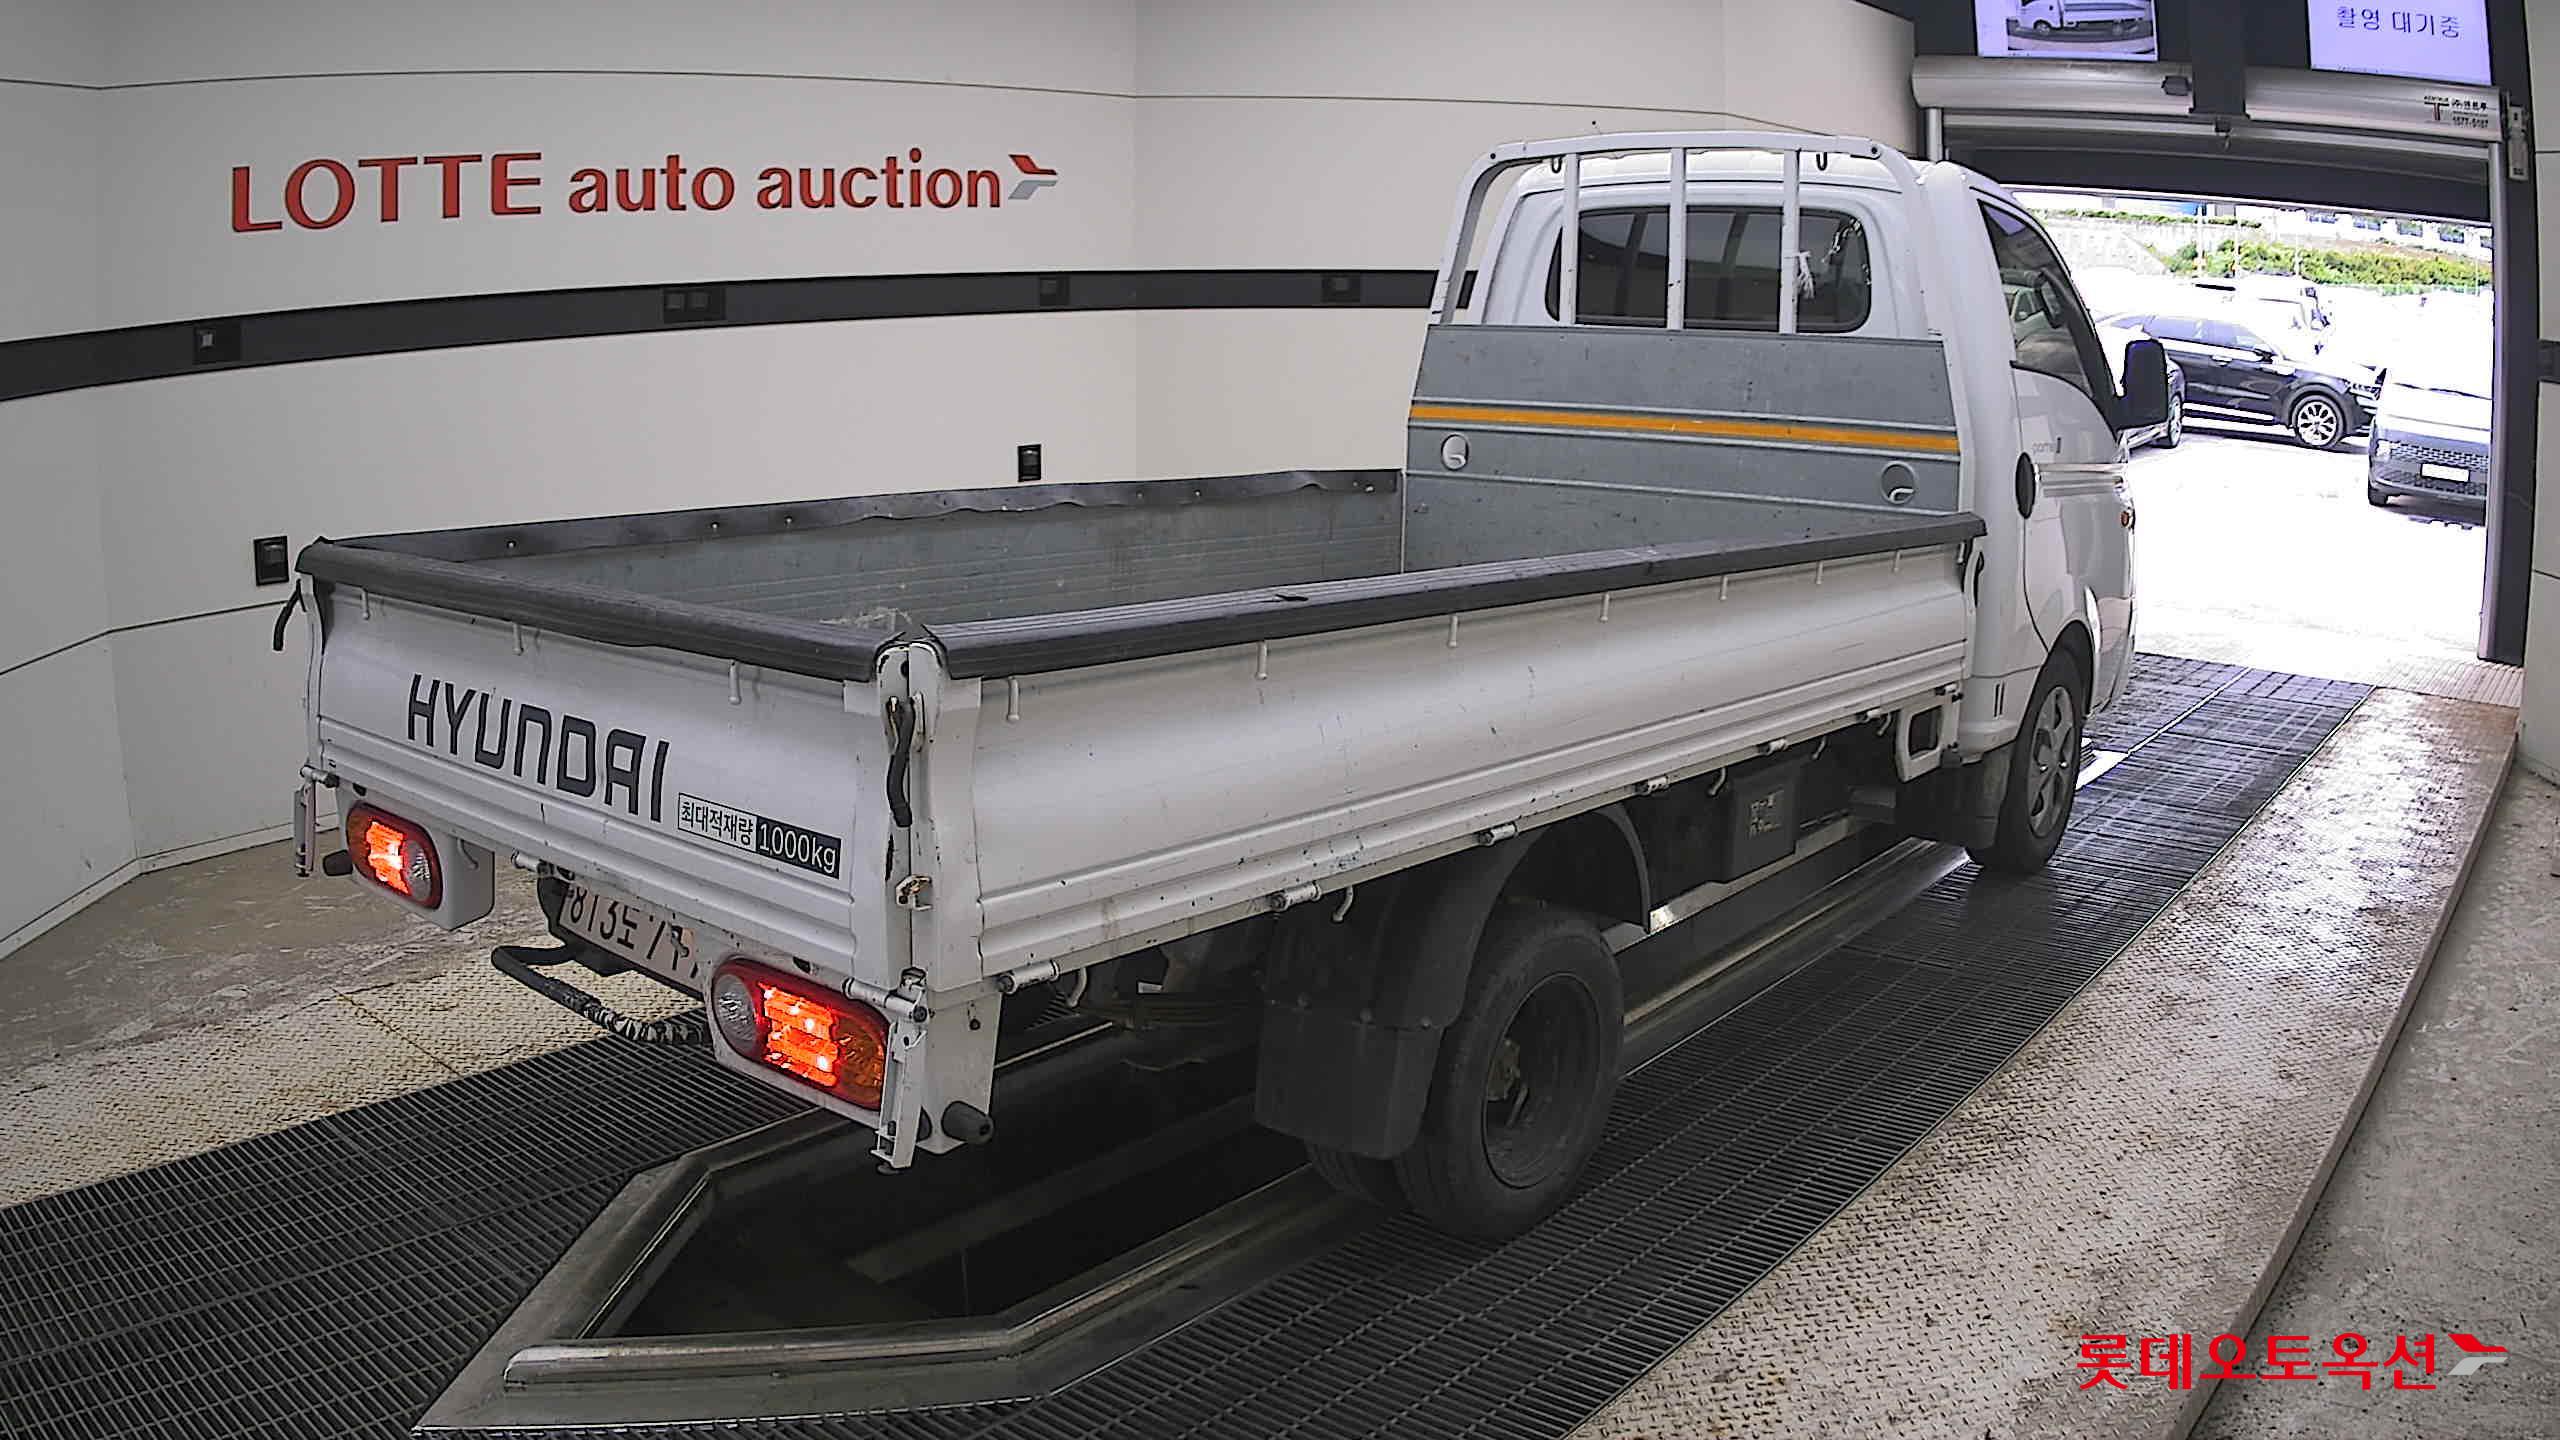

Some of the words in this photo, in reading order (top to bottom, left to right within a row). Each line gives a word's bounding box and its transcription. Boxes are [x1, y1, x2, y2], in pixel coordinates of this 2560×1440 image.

[2337, 6, 2380, 31] 촬영
[2392, 11, 2460, 39] 대기중
[231, 152, 542, 232] LOTTE
[568, 154, 735, 213] auto
[757, 147, 1001, 209] auction
[407, 673, 671, 823] HYUNDAI
[681, 801, 754, 846] 최대적재량
